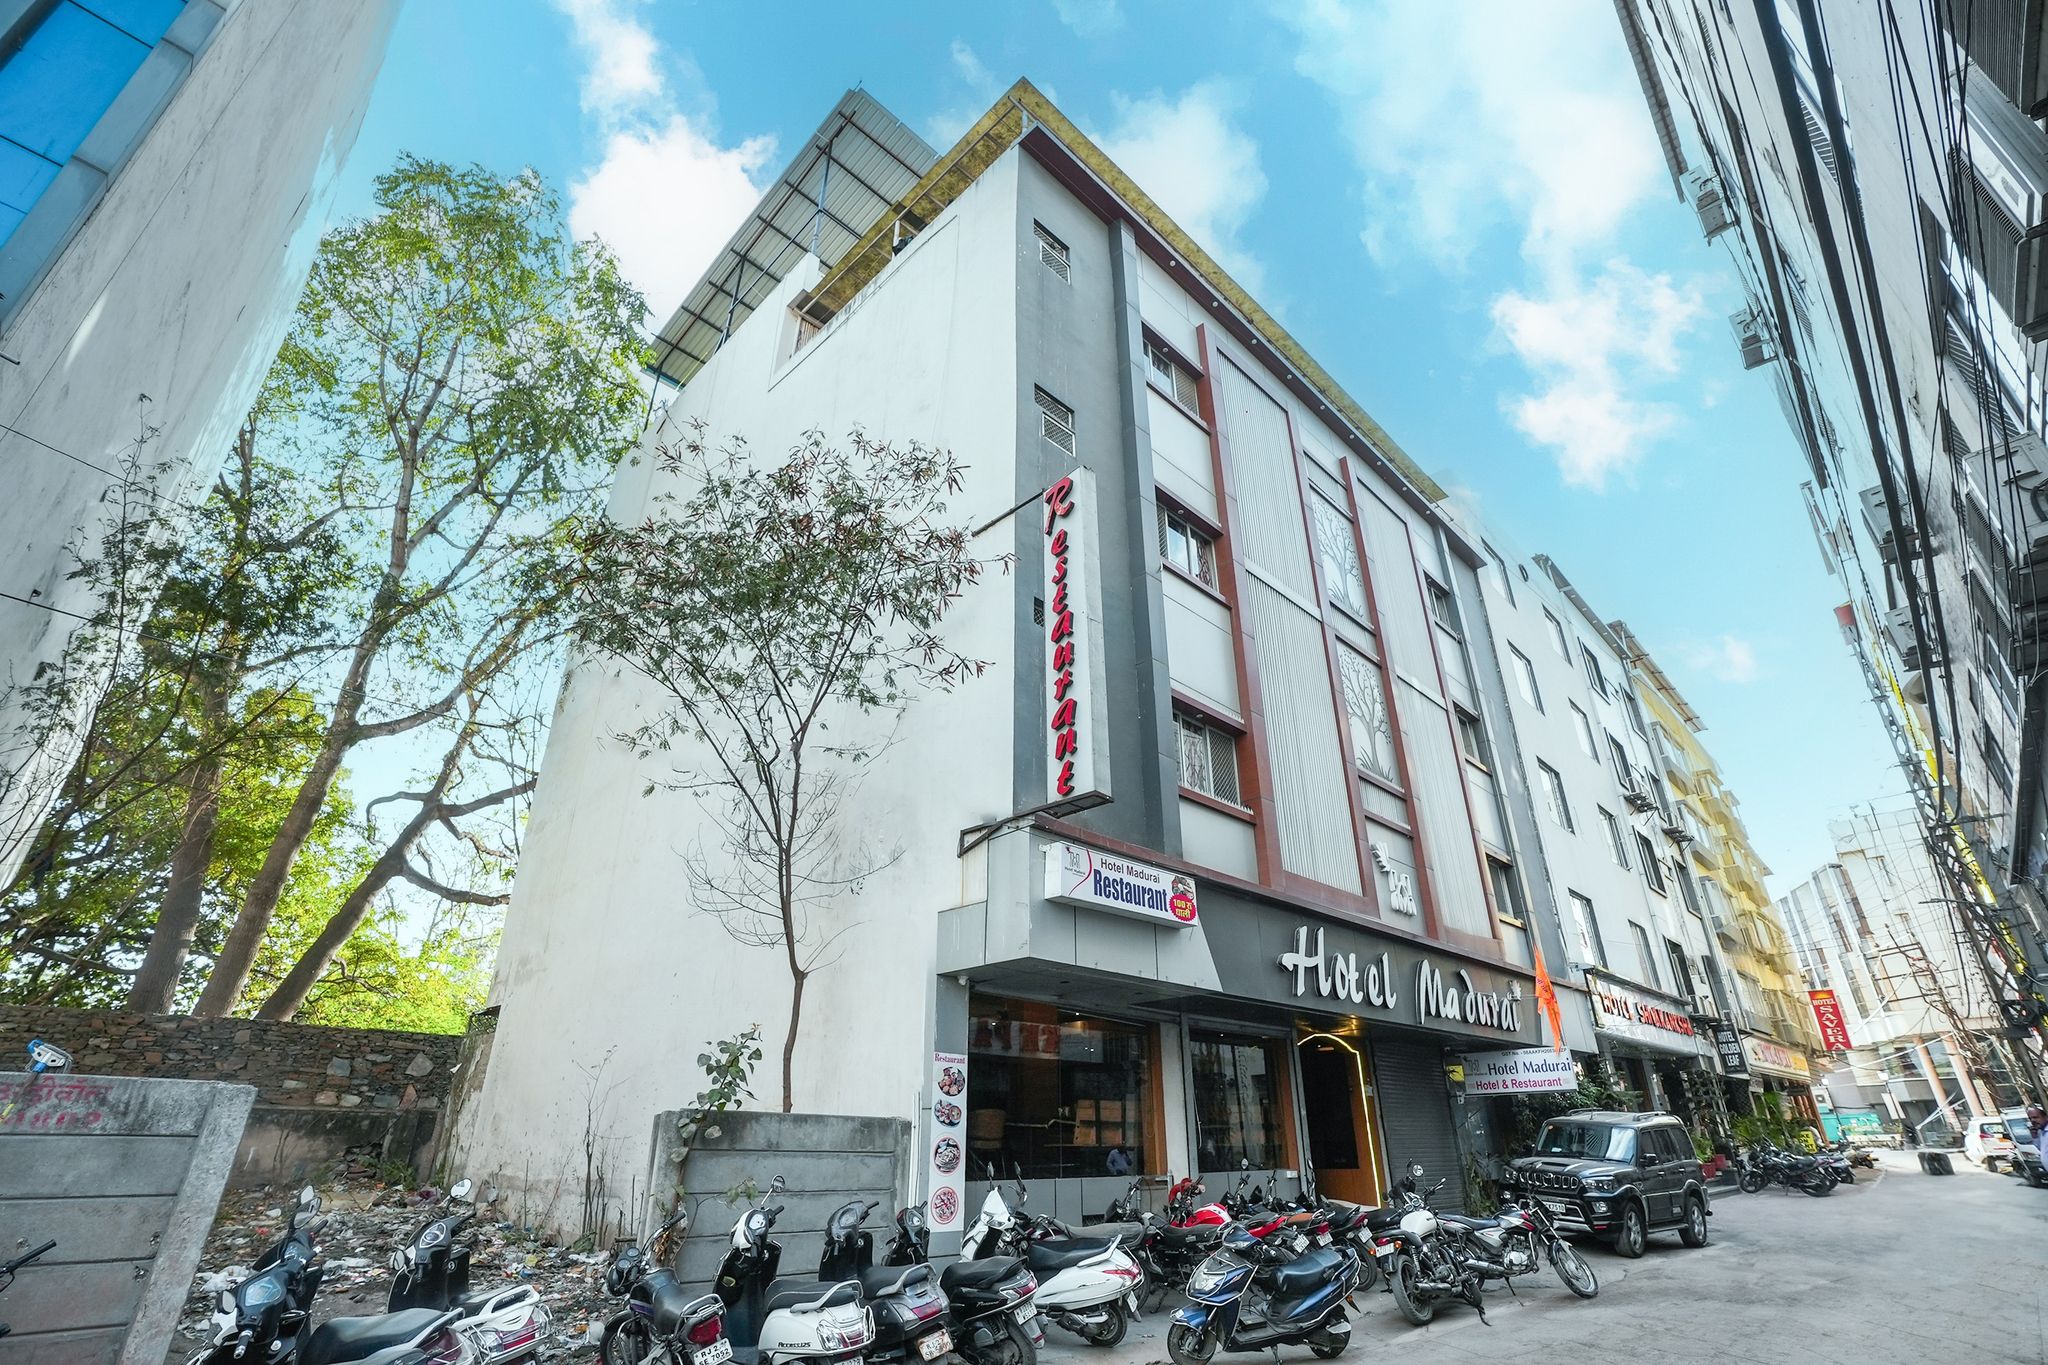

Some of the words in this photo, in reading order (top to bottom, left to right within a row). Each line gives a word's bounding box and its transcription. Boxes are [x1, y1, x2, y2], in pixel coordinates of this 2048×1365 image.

[1045, 477, 1077, 796] Restaurant
[1100, 857, 1124, 874] Hotel
[1126, 865, 1160, 884] Madurai
[1093, 868, 1169, 913] Restaurant
[1173, 899, 1185, 908] 100
[1279, 926, 1396, 1009] Hotel
[1416, 959, 1522, 1032] Madurai
[1819, 1005, 1847, 1050] SAVERA
[1717, 1031, 1736, 1042] HOTEL
[1719, 1043, 1740, 1055] GOLDEN
[935, 1052, 965, 1064] Restaurant
[1725, 1054, 1740, 1067] LEAF
[1487, 1061, 1519, 1077] Hotel
[1523, 1058, 1572, 1074] Madurai
[1476, 1080, 1499, 1090] Hotel
[1501, 1080, 1509, 1089] &
[1511, 1077, 1563, 1089] Restaurant
